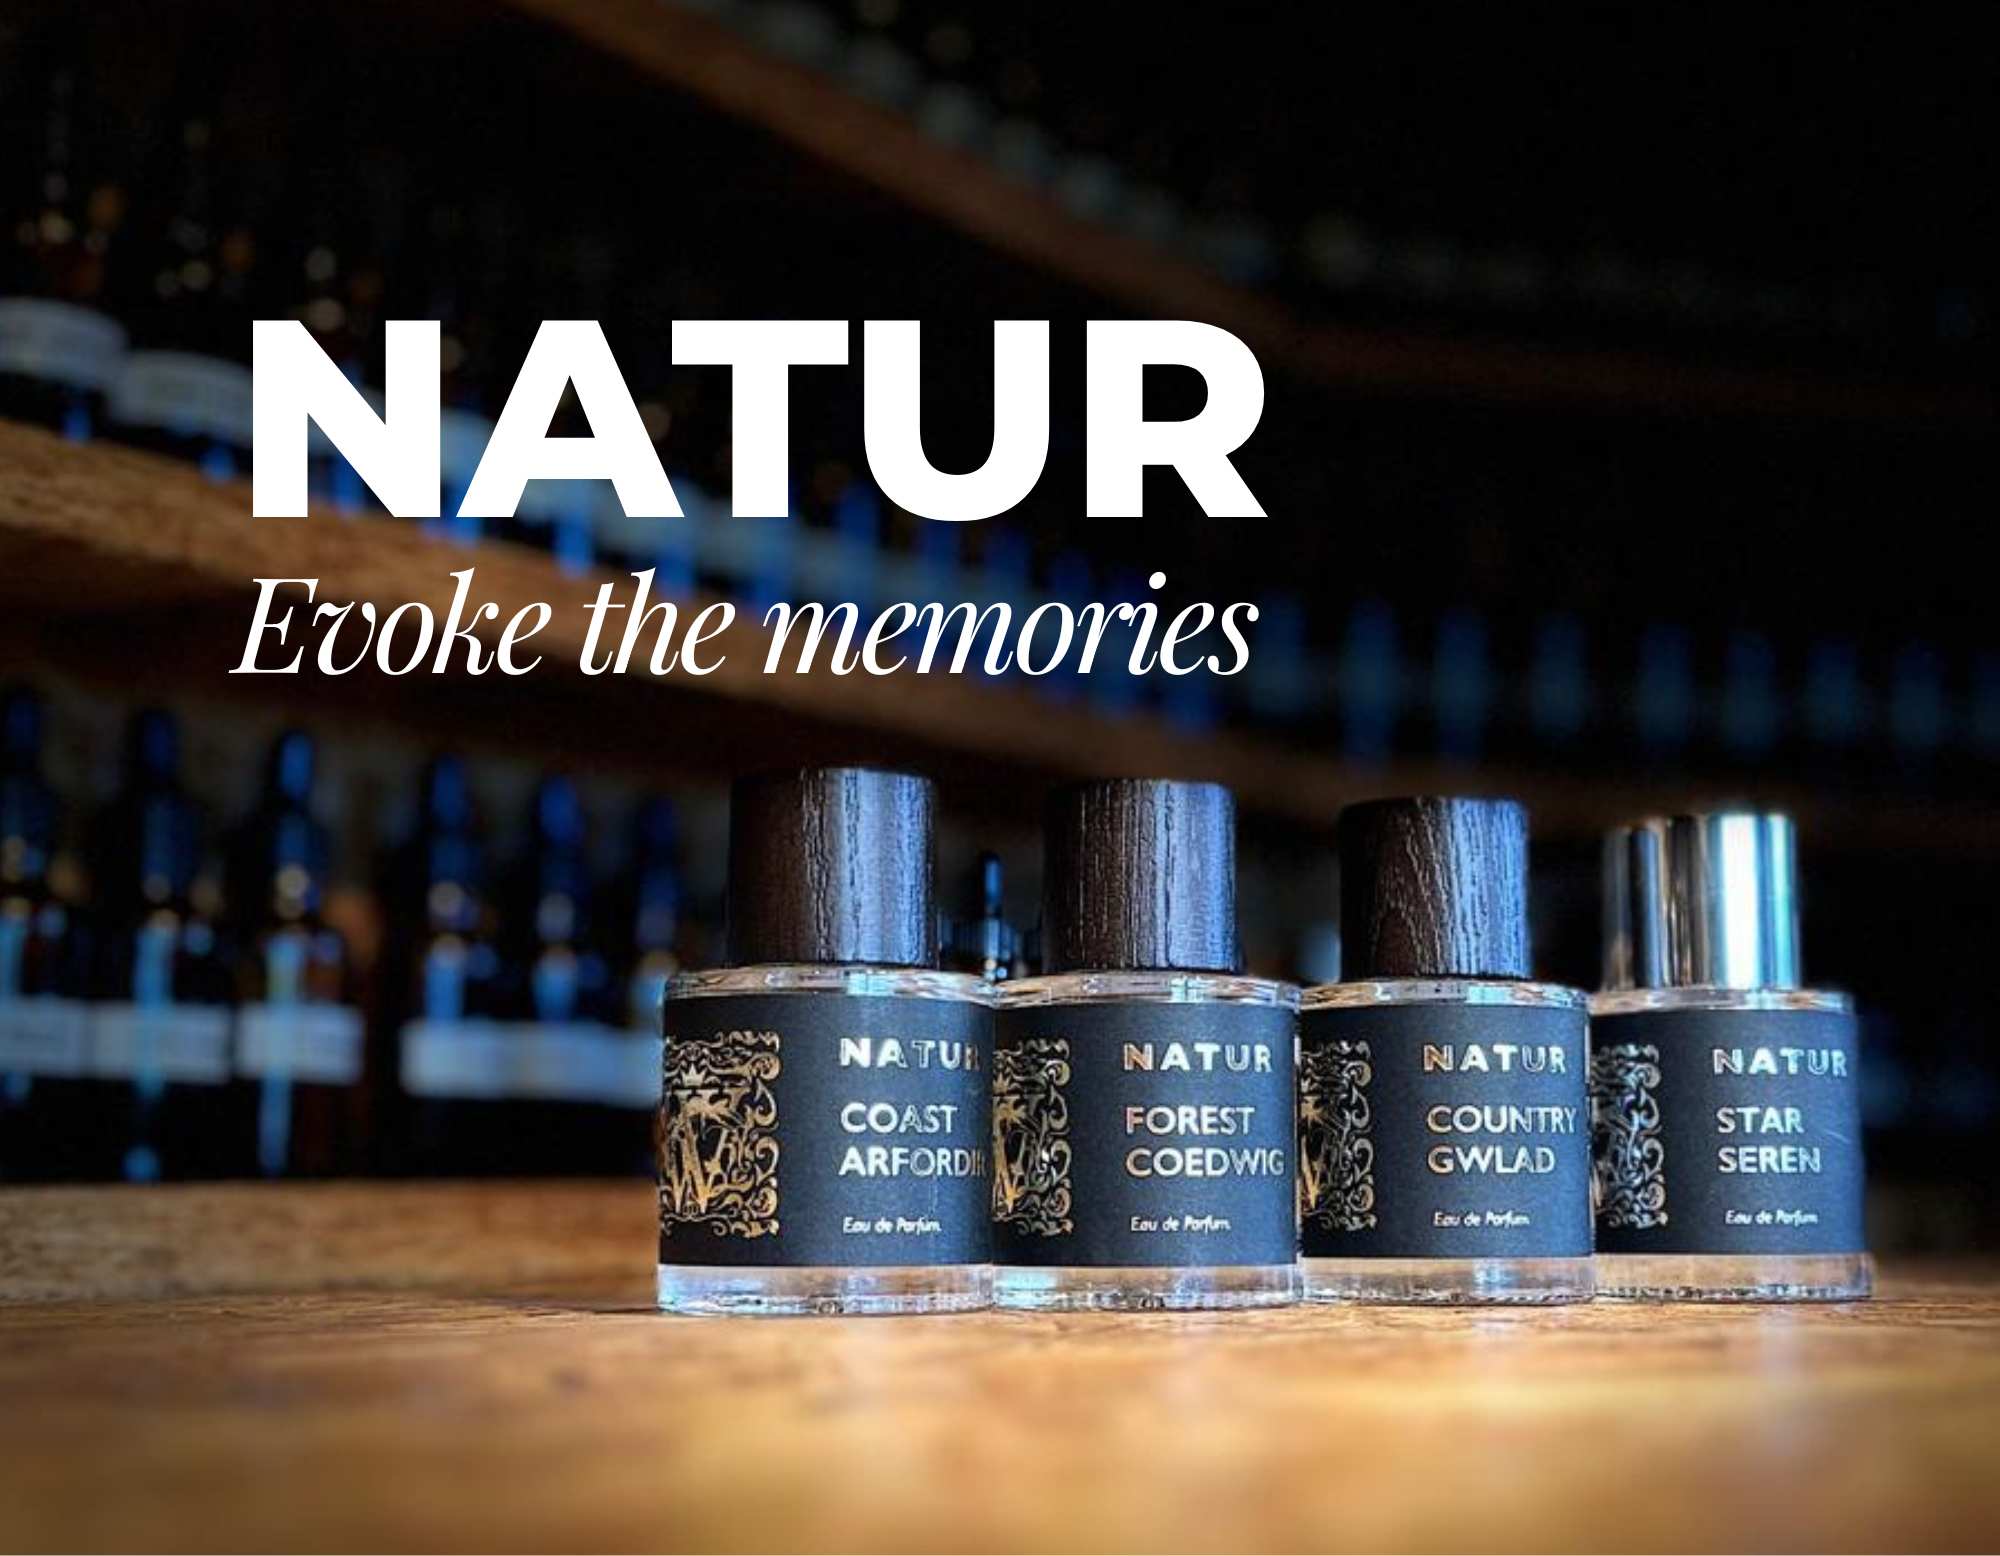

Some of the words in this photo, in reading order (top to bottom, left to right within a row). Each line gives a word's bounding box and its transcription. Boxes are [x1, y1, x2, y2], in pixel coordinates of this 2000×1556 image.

[1123, 1042, 1272, 1073] NATUR
[1423, 1044, 1566, 1073] NATUR
[1713, 1048, 1847, 1077] NATUR
[840, 1102, 958, 1134] COAST
[1125, 1105, 1256, 1135] FOREST
[1427, 1105, 1577, 1134] COUNTRY
[1716, 1106, 1805, 1134] STAR
[1125, 1147, 1285, 1177] COEDWIG
[1427, 1145, 1556, 1174] GWLAD
[1718, 1145, 1821, 1173] SEREN
[842, 1216, 872, 1234] Eau
[874, 1216, 894, 1233] de
[1130, 1216, 1159, 1232] Eau
[1162, 1215, 1180, 1232] de
[1434, 1211, 1461, 1227] Eau
[1463, 1210, 1481, 1227] de
[1724, 1209, 1753, 1225] Eau
[1755, 1209, 1773, 1225] de
